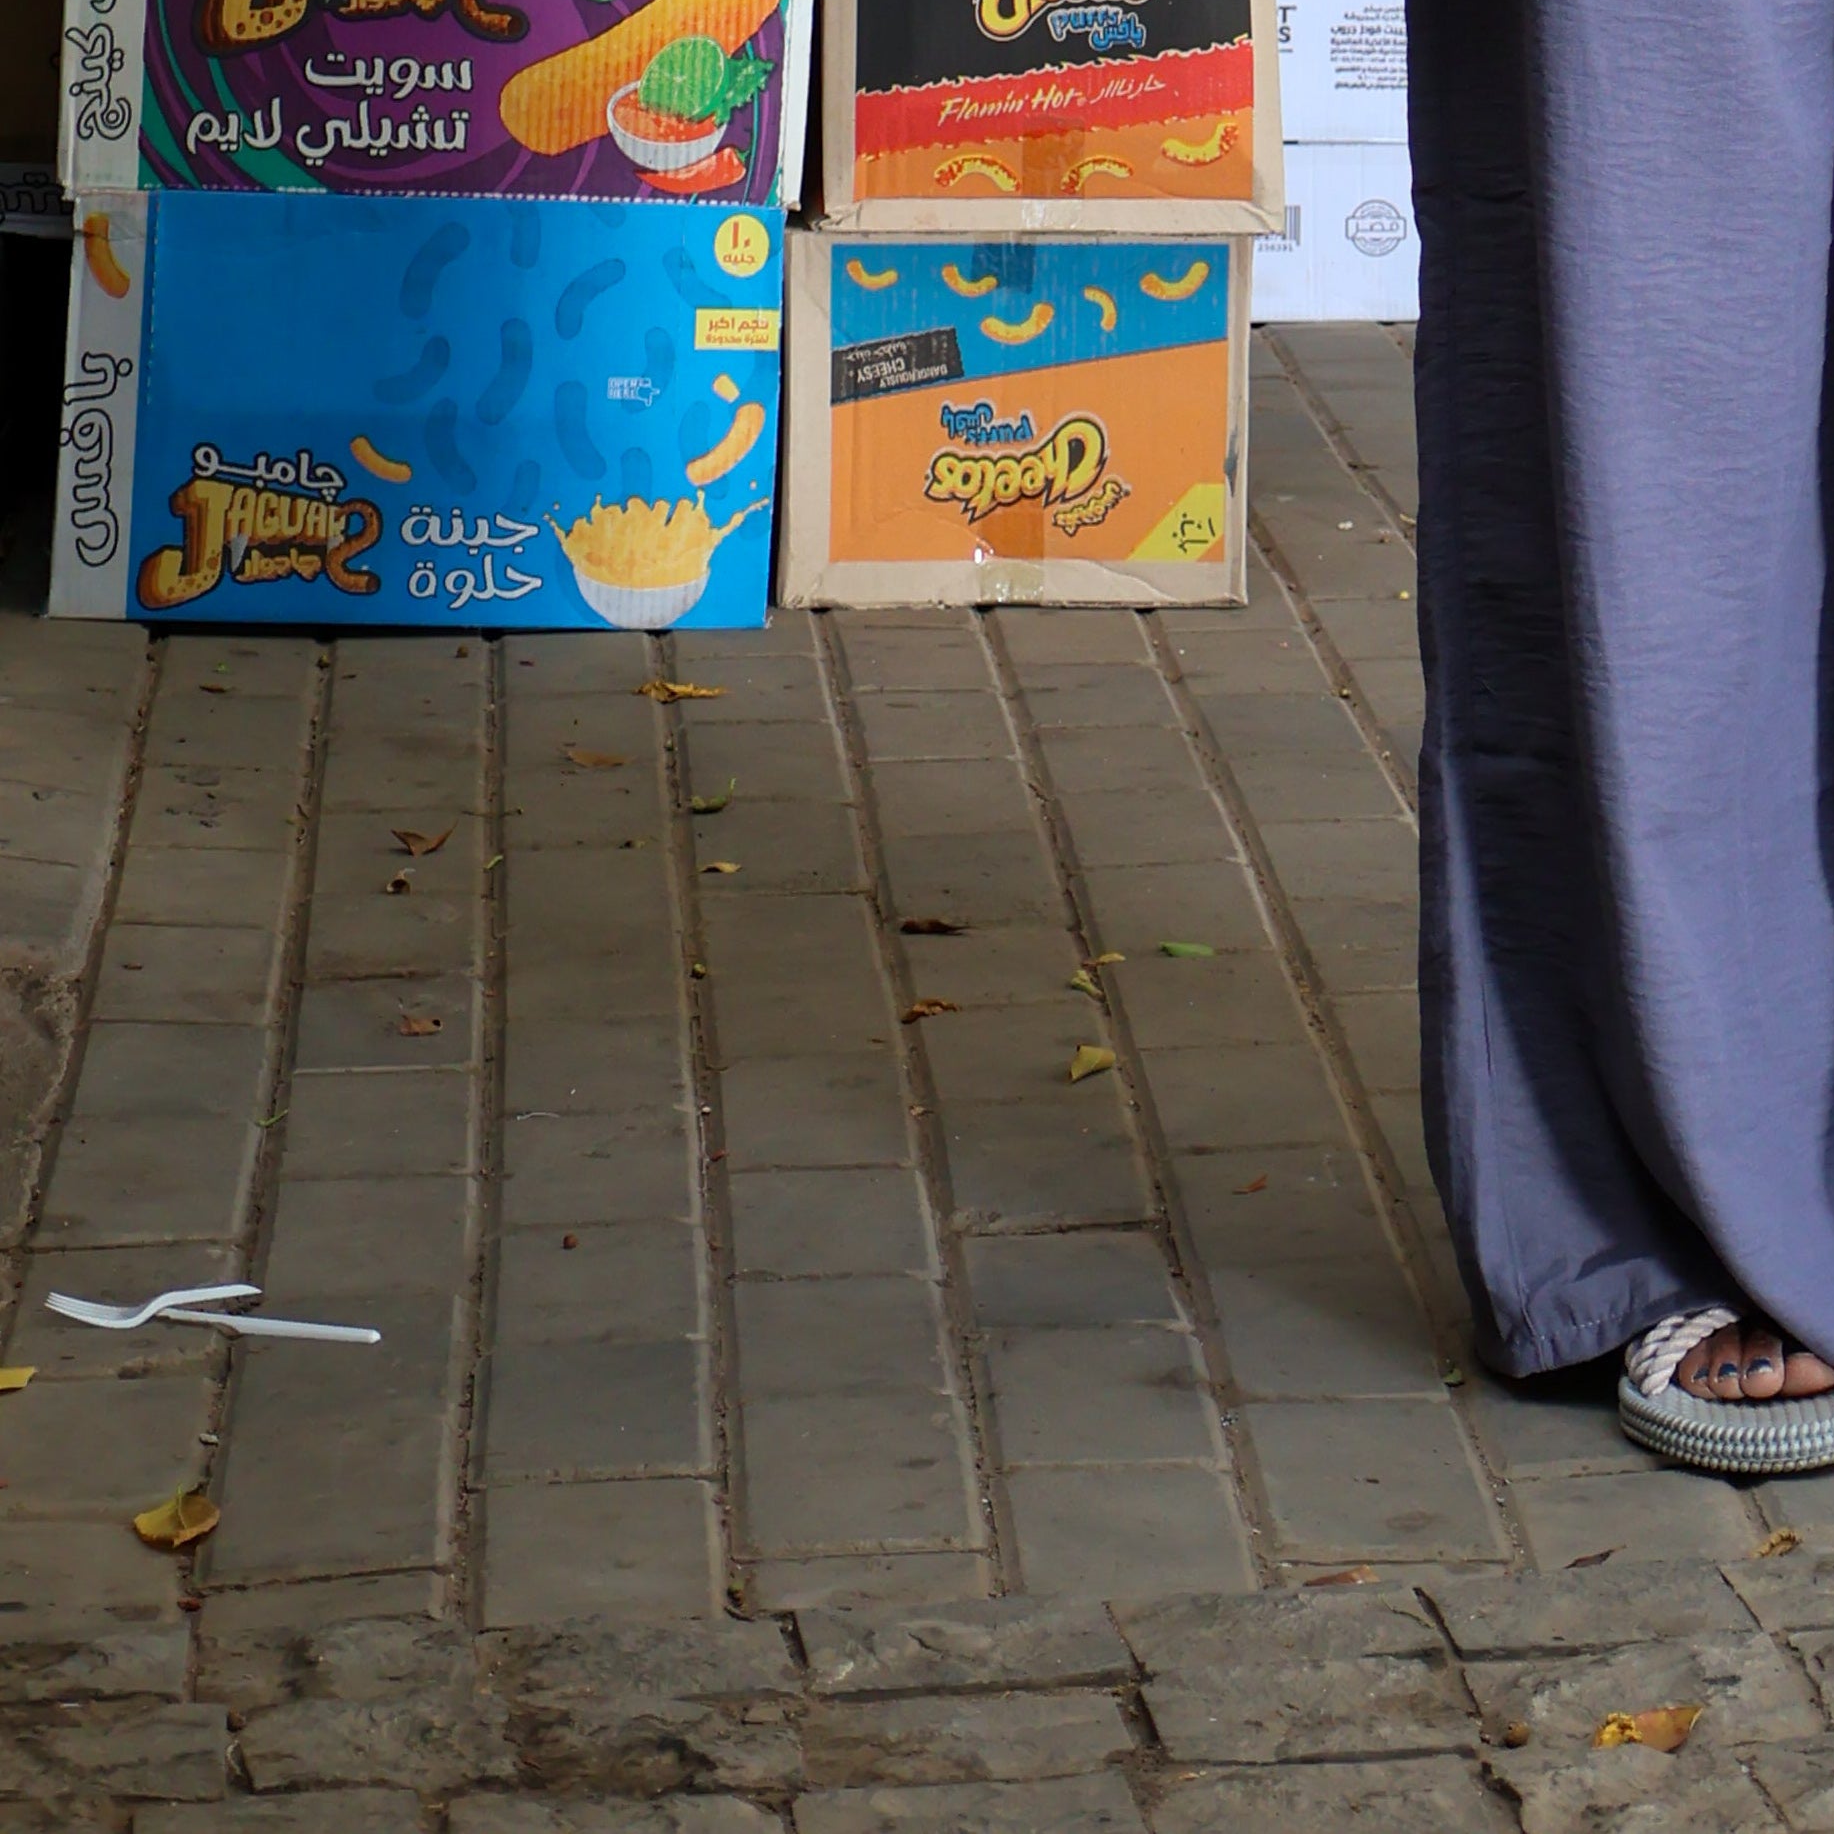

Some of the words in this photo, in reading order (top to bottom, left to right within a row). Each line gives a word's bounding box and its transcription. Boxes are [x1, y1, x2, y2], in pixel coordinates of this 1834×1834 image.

[305, 51, 473, 92] سويت
[185, 105, 282, 157] لايم
[924, 417, 1107, 525] Cheetos
[137, 481, 381, 611] JAGUAR
[401, 506, 542, 550] جبنة
[409, 553, 545, 609] حلوة
